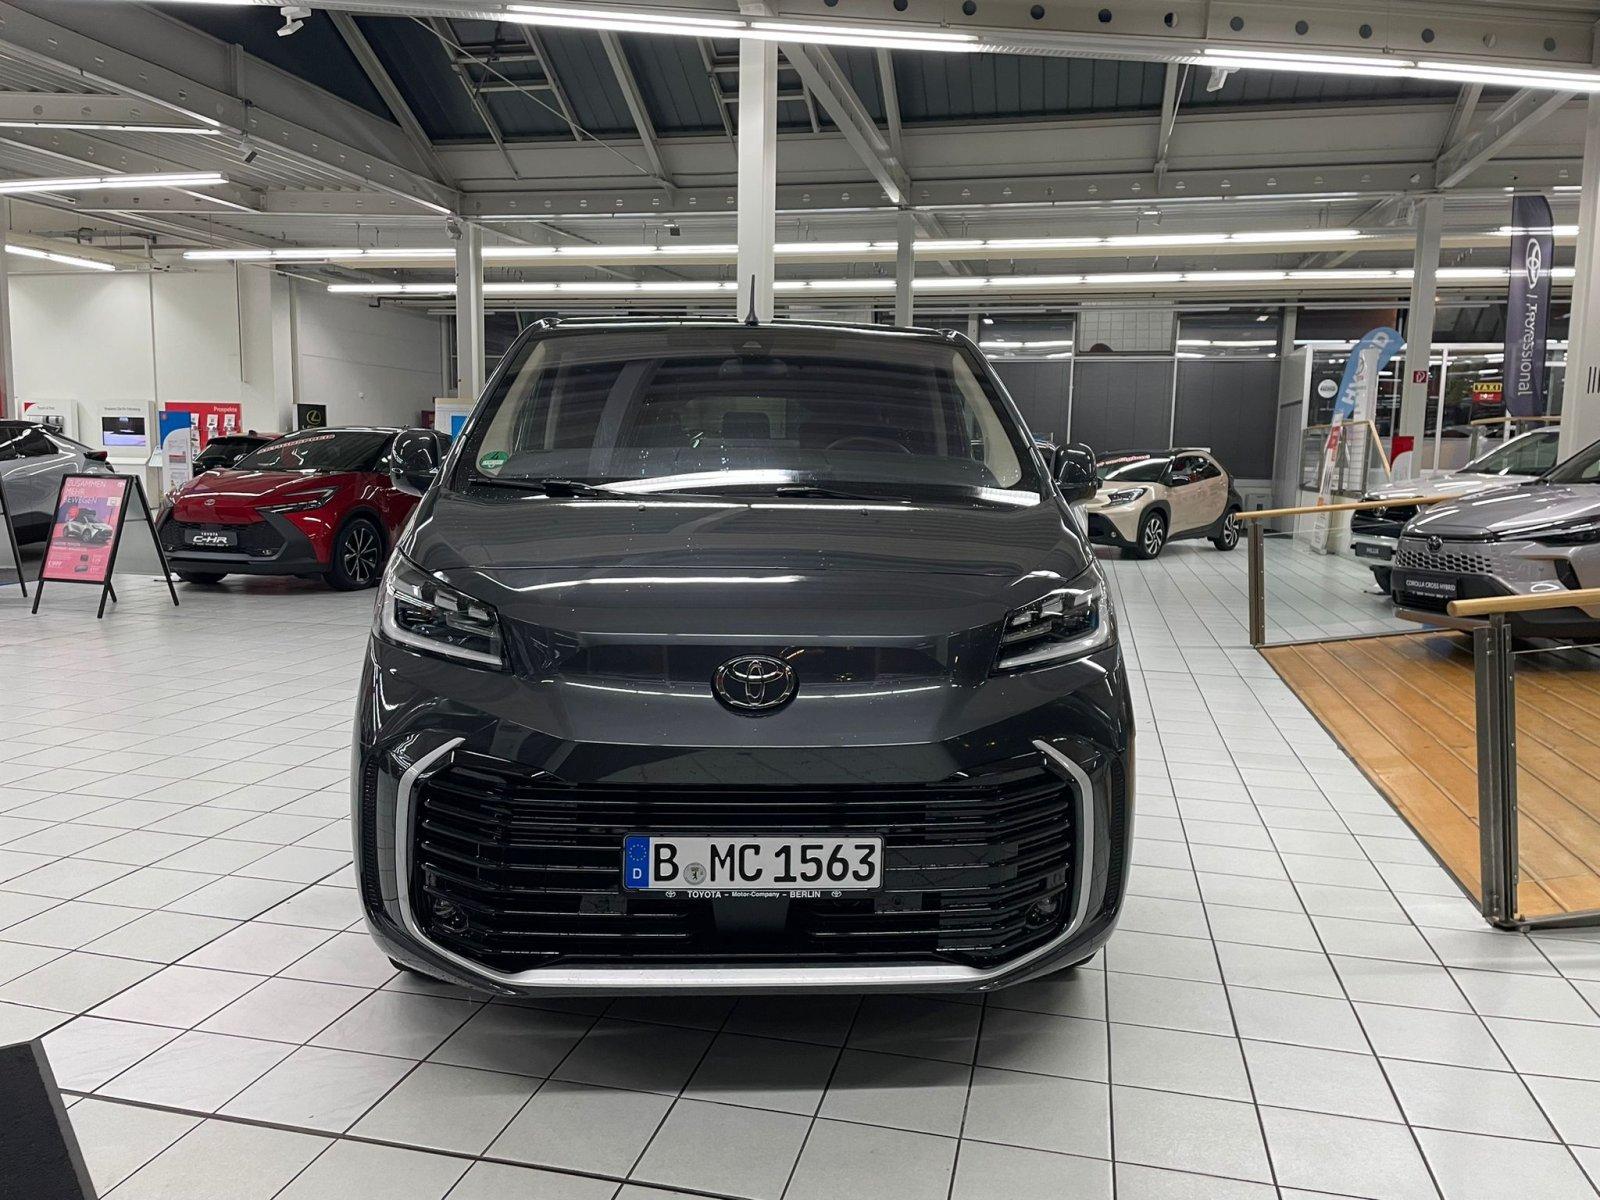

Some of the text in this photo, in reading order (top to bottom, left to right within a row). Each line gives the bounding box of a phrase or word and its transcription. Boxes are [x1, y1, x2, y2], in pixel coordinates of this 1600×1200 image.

[213, 405, 238, 413] Prospekte
[66, 479, 107, 488] ZUSAMMEN
[192, 535, 228, 544] C-HR
[1405, 579, 1456, 592] COROLLA CROSS HYBRID
[653, 843, 876, 883] B MC 1563
[632, 868, 642, 879] D
[687, 890, 722, 899] TOYOTA
[731, 890, 780, 900] Motor-Company
[789, 890, 821, 898] BERLIN
